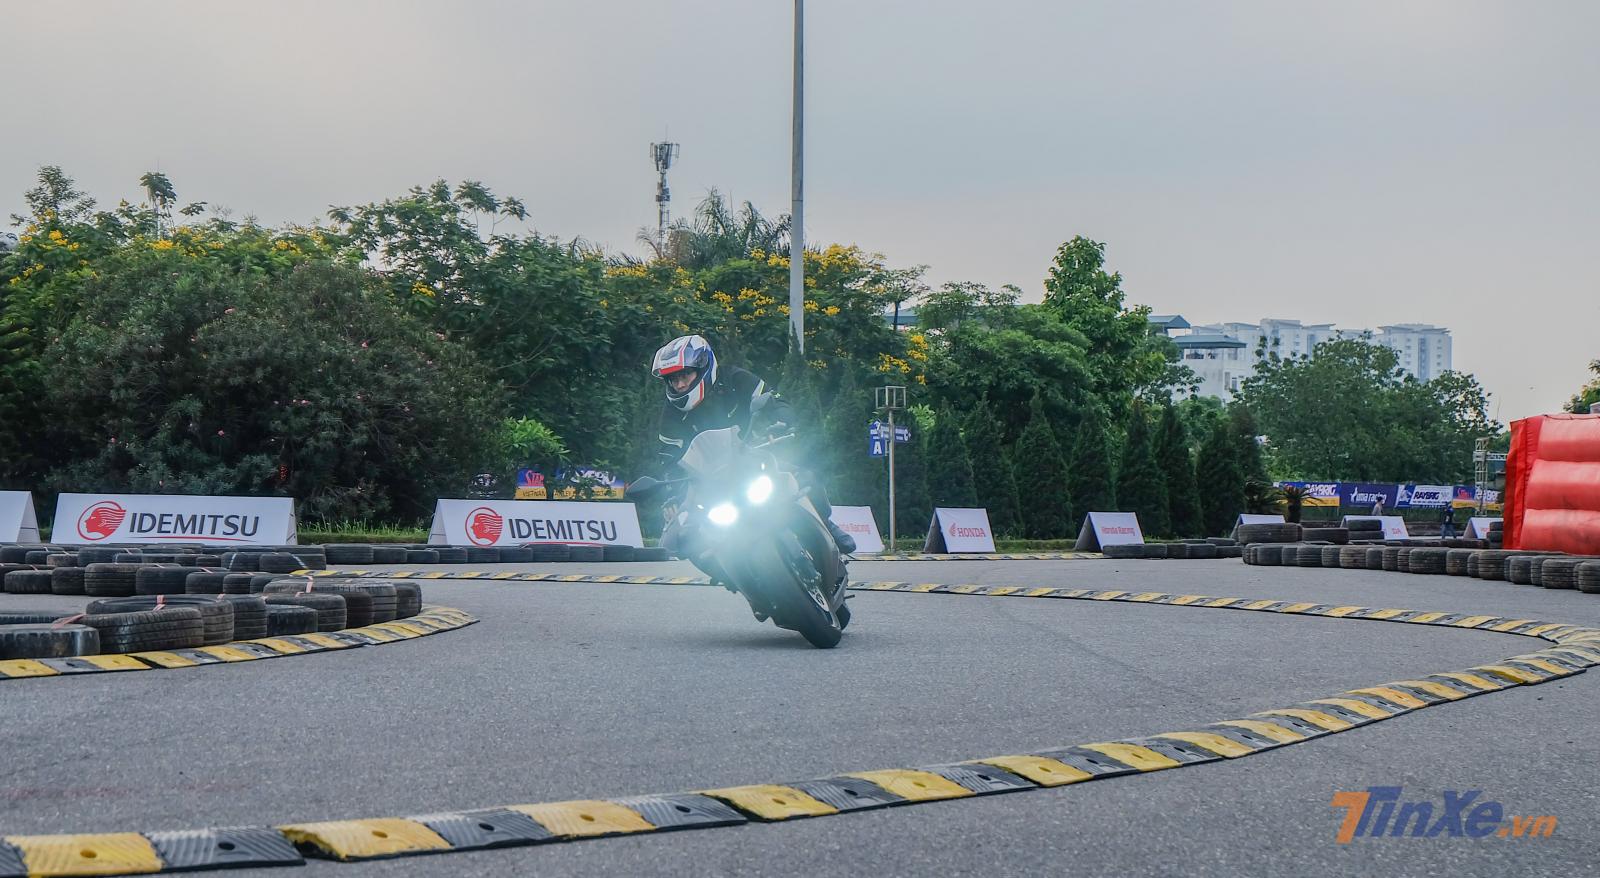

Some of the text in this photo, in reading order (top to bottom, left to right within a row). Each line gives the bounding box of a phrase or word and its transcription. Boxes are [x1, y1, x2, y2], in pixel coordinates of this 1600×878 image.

[873, 441, 882, 454] A
[1413, 491, 1440, 500] RAYBRIG
[129, 512, 260, 537] IDEMITSU
[508, 518, 618, 541] IDEMITSU
[957, 527, 986, 538] HONDA
[1101, 526, 1136, 536] Honda Racing
